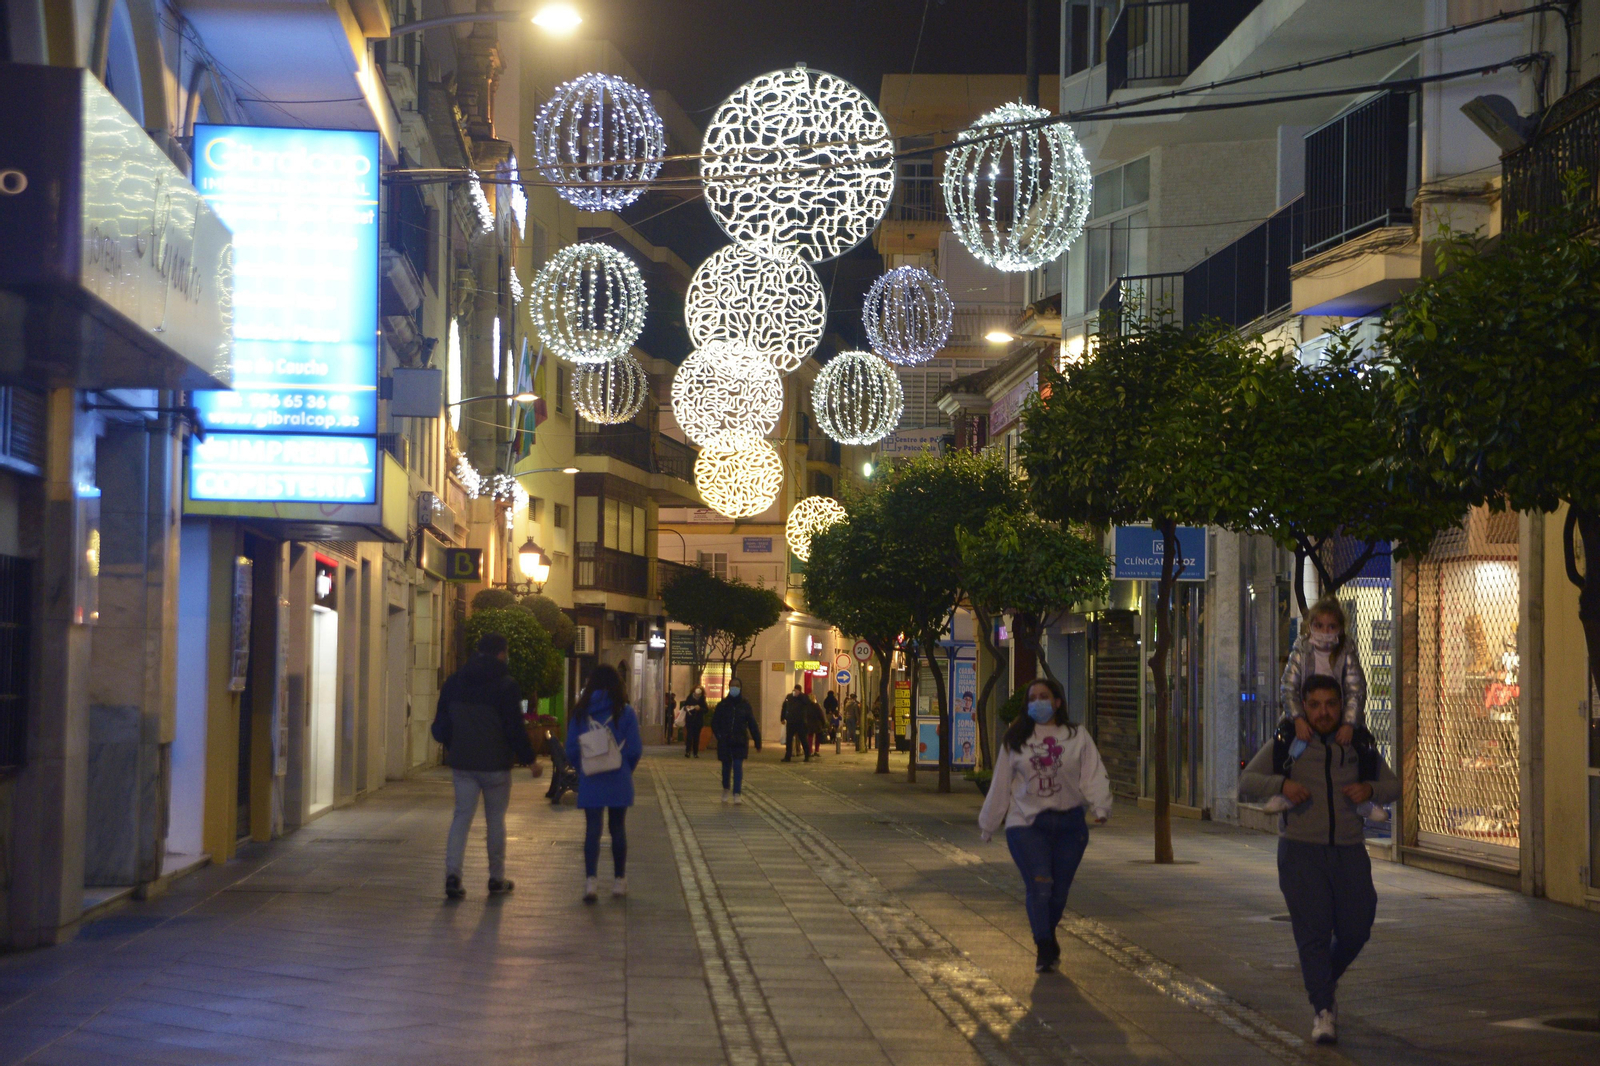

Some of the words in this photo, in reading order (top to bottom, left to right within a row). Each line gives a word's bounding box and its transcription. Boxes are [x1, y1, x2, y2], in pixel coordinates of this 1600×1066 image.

[284, 395, 302, 408] 65
[307, 396, 326, 409] 36
[208, 411, 360, 429] www.gibralcop.es
[229, 440, 368, 464] IMPRENTA
[198, 472, 365, 497] COPISTERIA
[454, 551, 475, 576] B
[857, 646, 869, 655] 20
